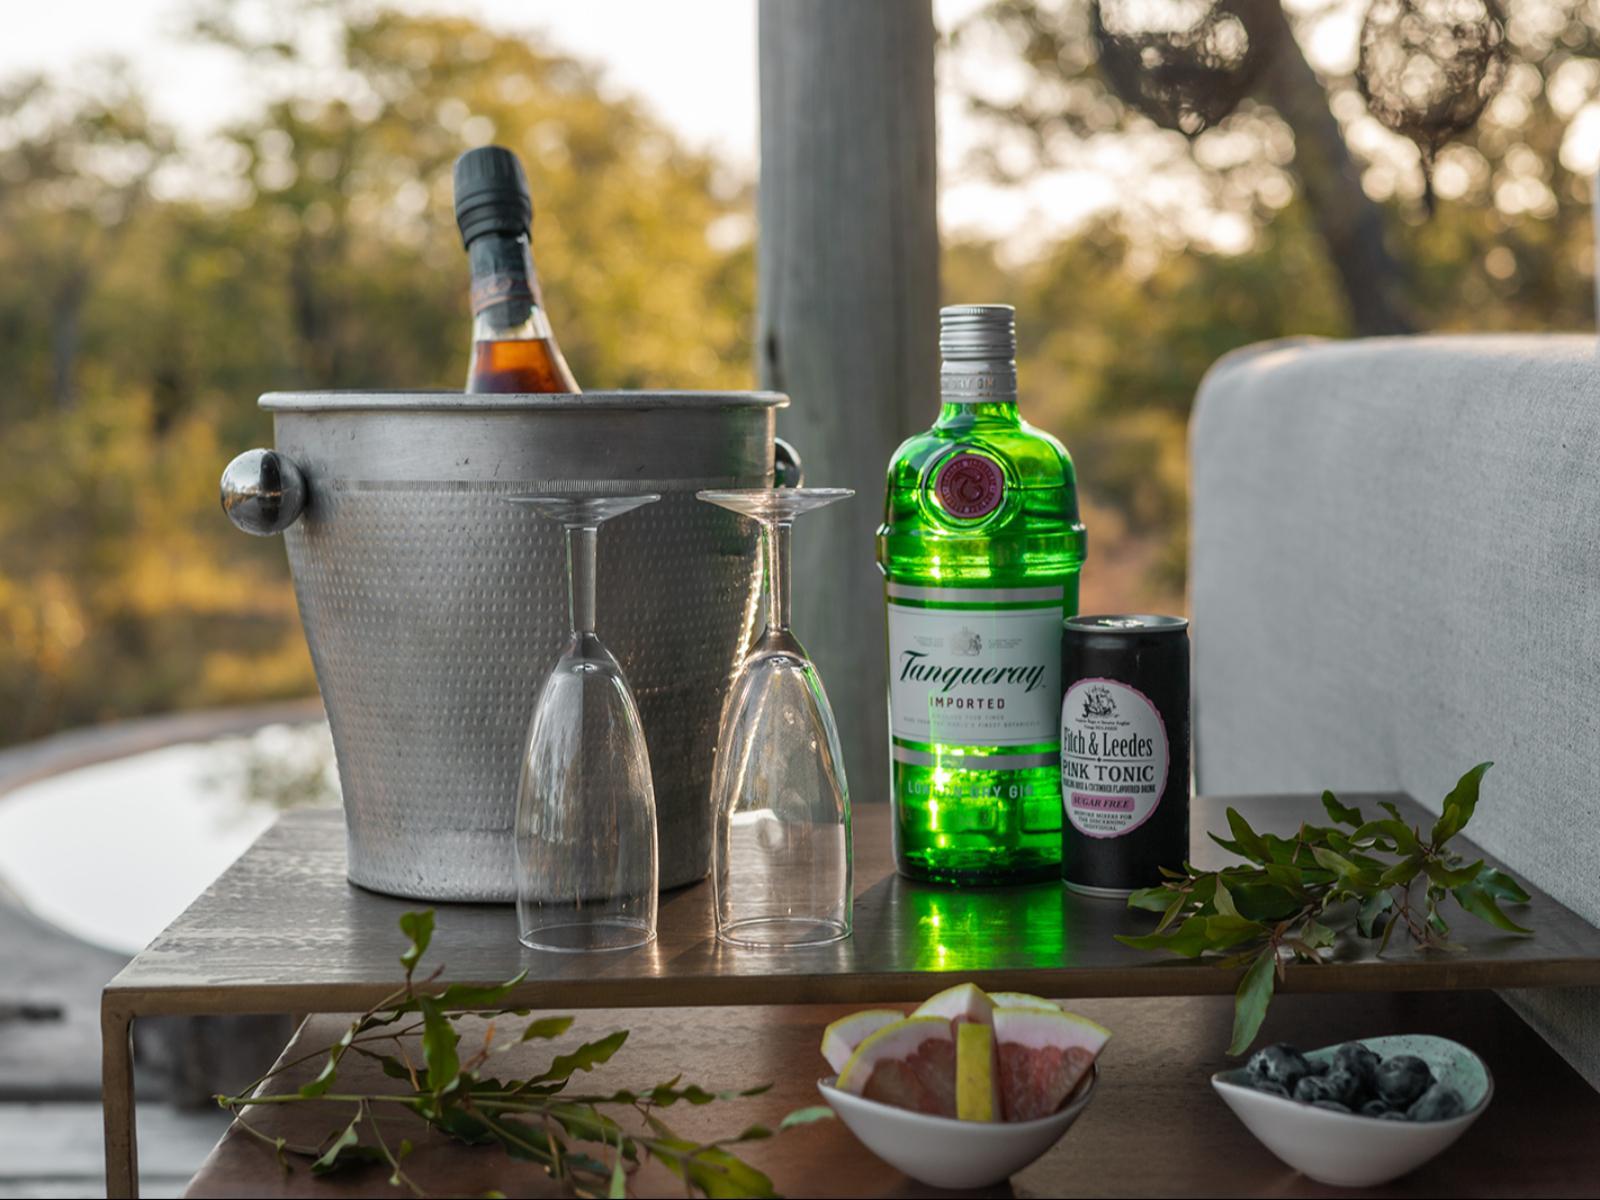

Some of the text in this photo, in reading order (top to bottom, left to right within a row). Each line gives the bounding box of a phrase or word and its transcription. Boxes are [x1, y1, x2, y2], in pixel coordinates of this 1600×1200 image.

[899, 649, 1046, 693] Tanqueray
[930, 697, 1006, 710] IMPORTED
[1063, 726, 1153, 758] Fitch & Leedes
[1063, 758, 1154, 782] PINK TONIC
[1072, 796, 1130, 809] SUGAR FREE
